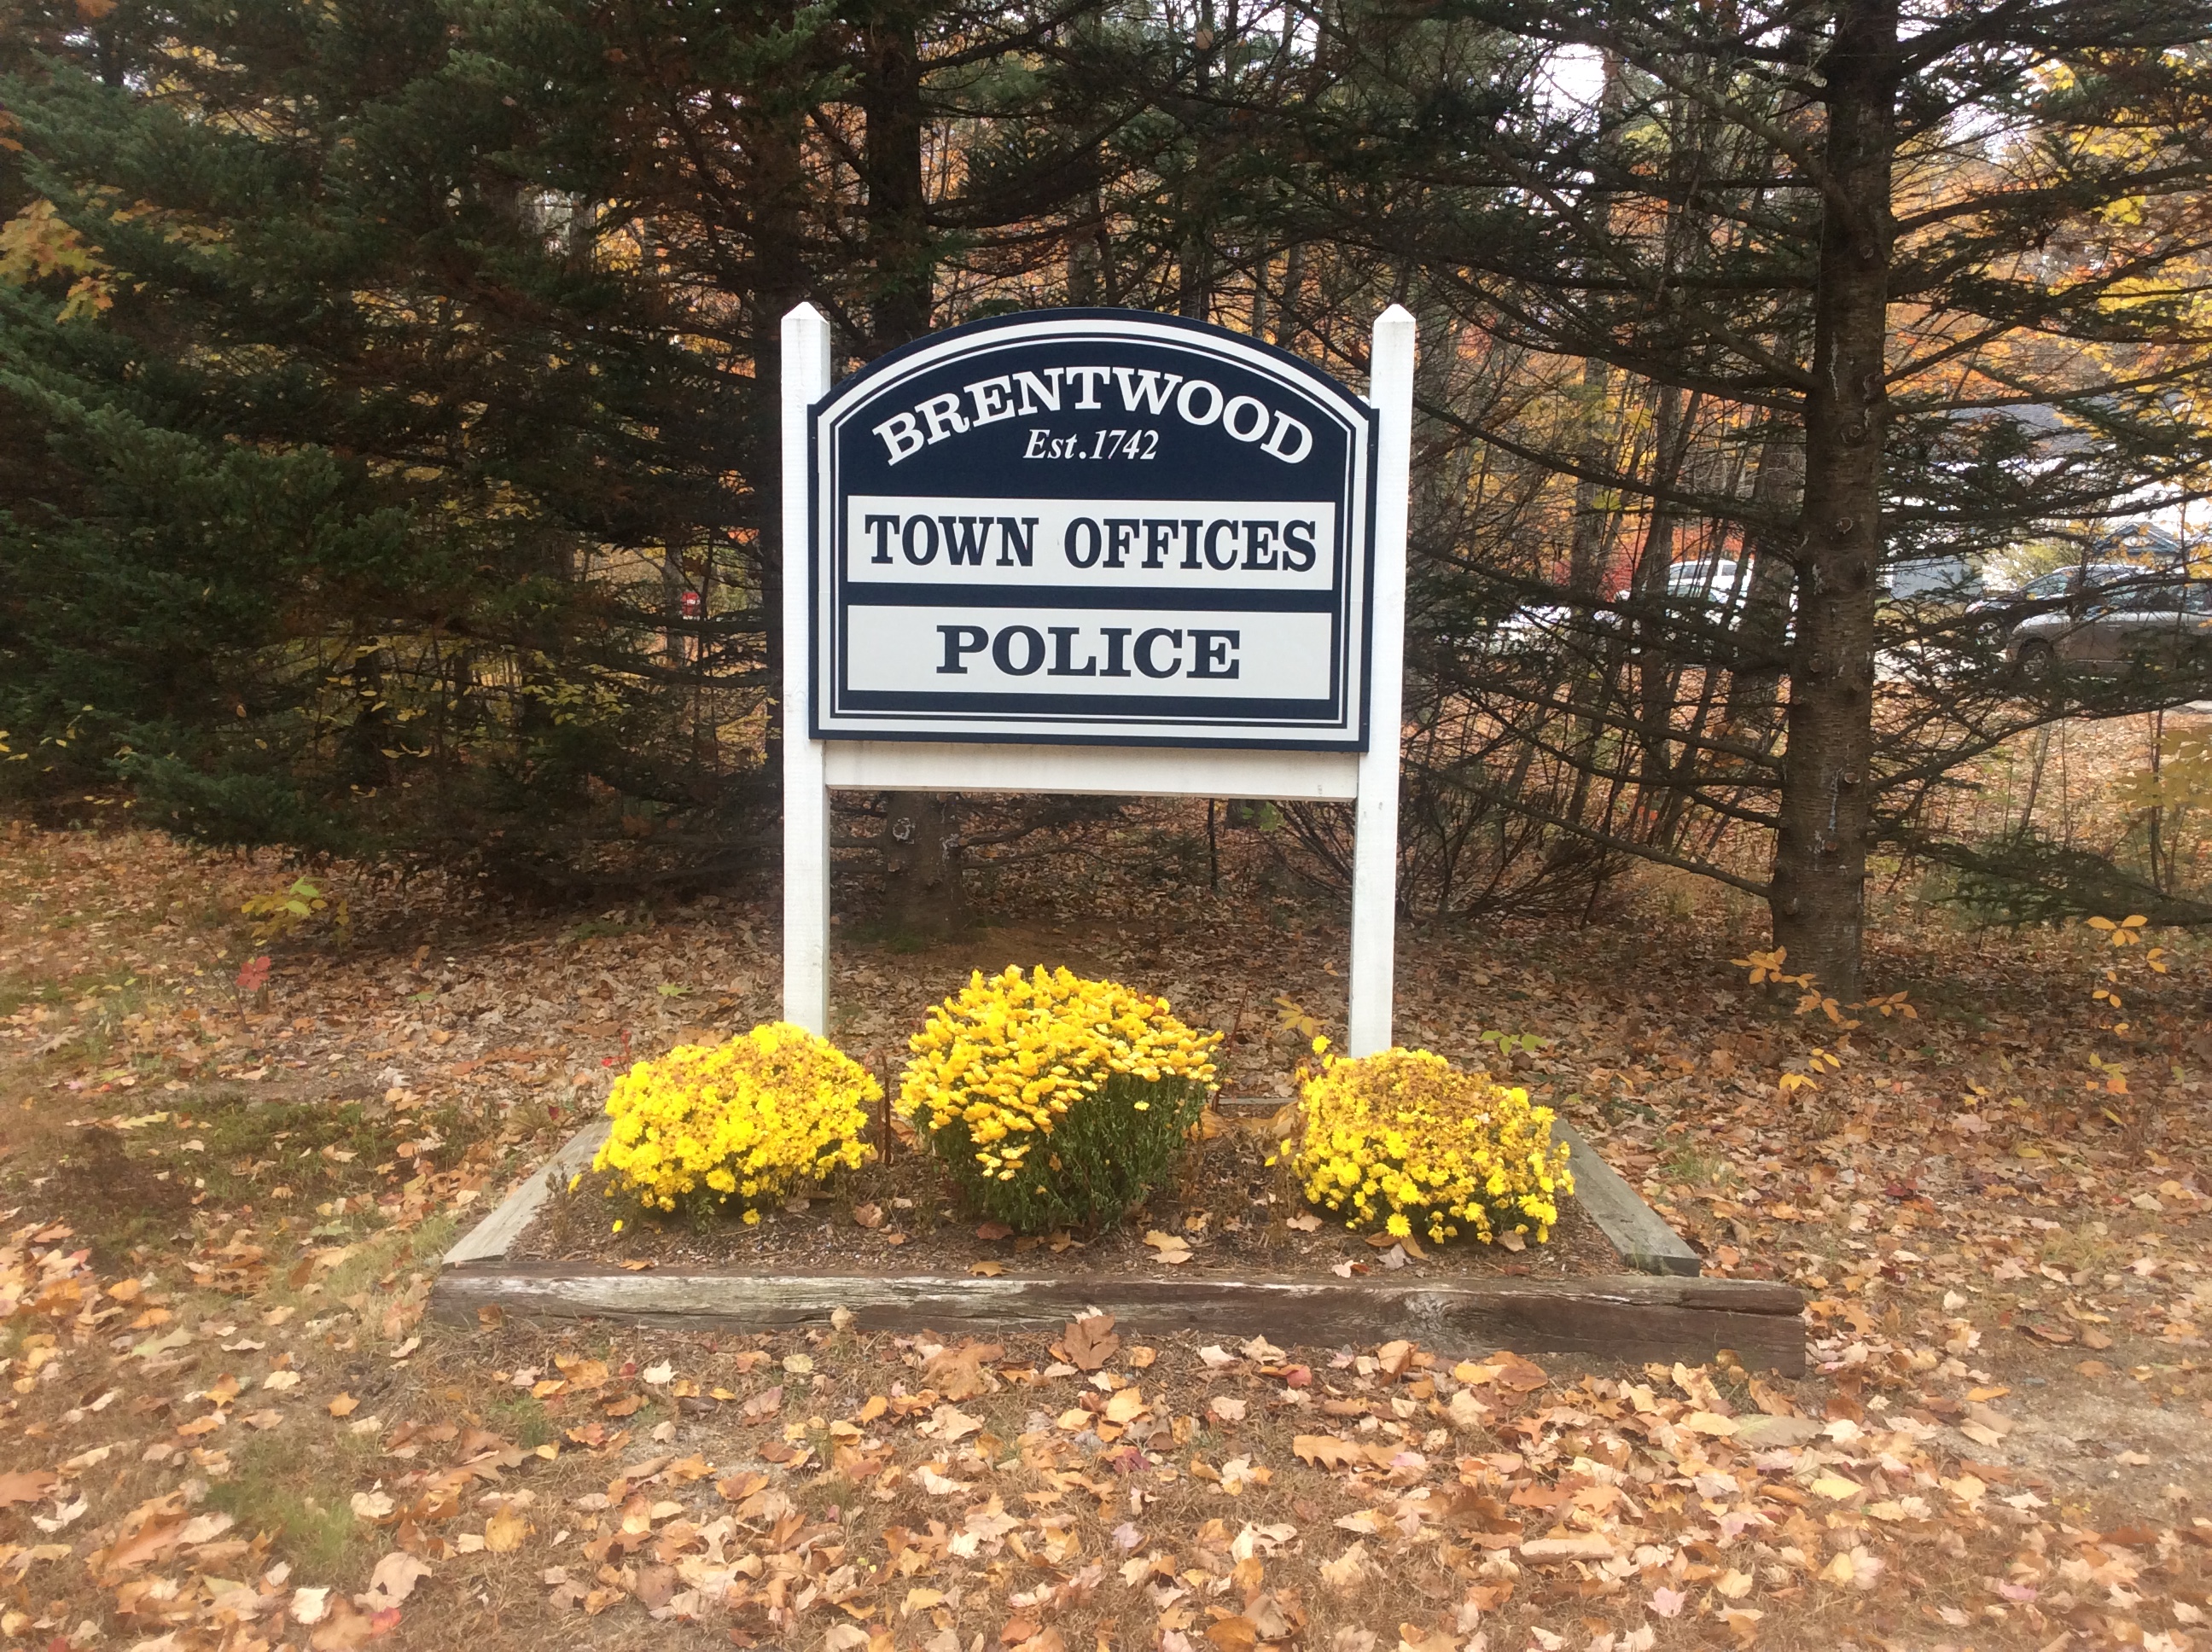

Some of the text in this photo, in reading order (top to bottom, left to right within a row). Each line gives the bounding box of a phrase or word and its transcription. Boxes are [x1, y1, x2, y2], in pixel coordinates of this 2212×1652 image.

[872, 367, 1313, 466] BRENTWOOD
[865, 515, 1316, 572] TOWN OFFICES
[936, 625, 1240, 679] POLICE
